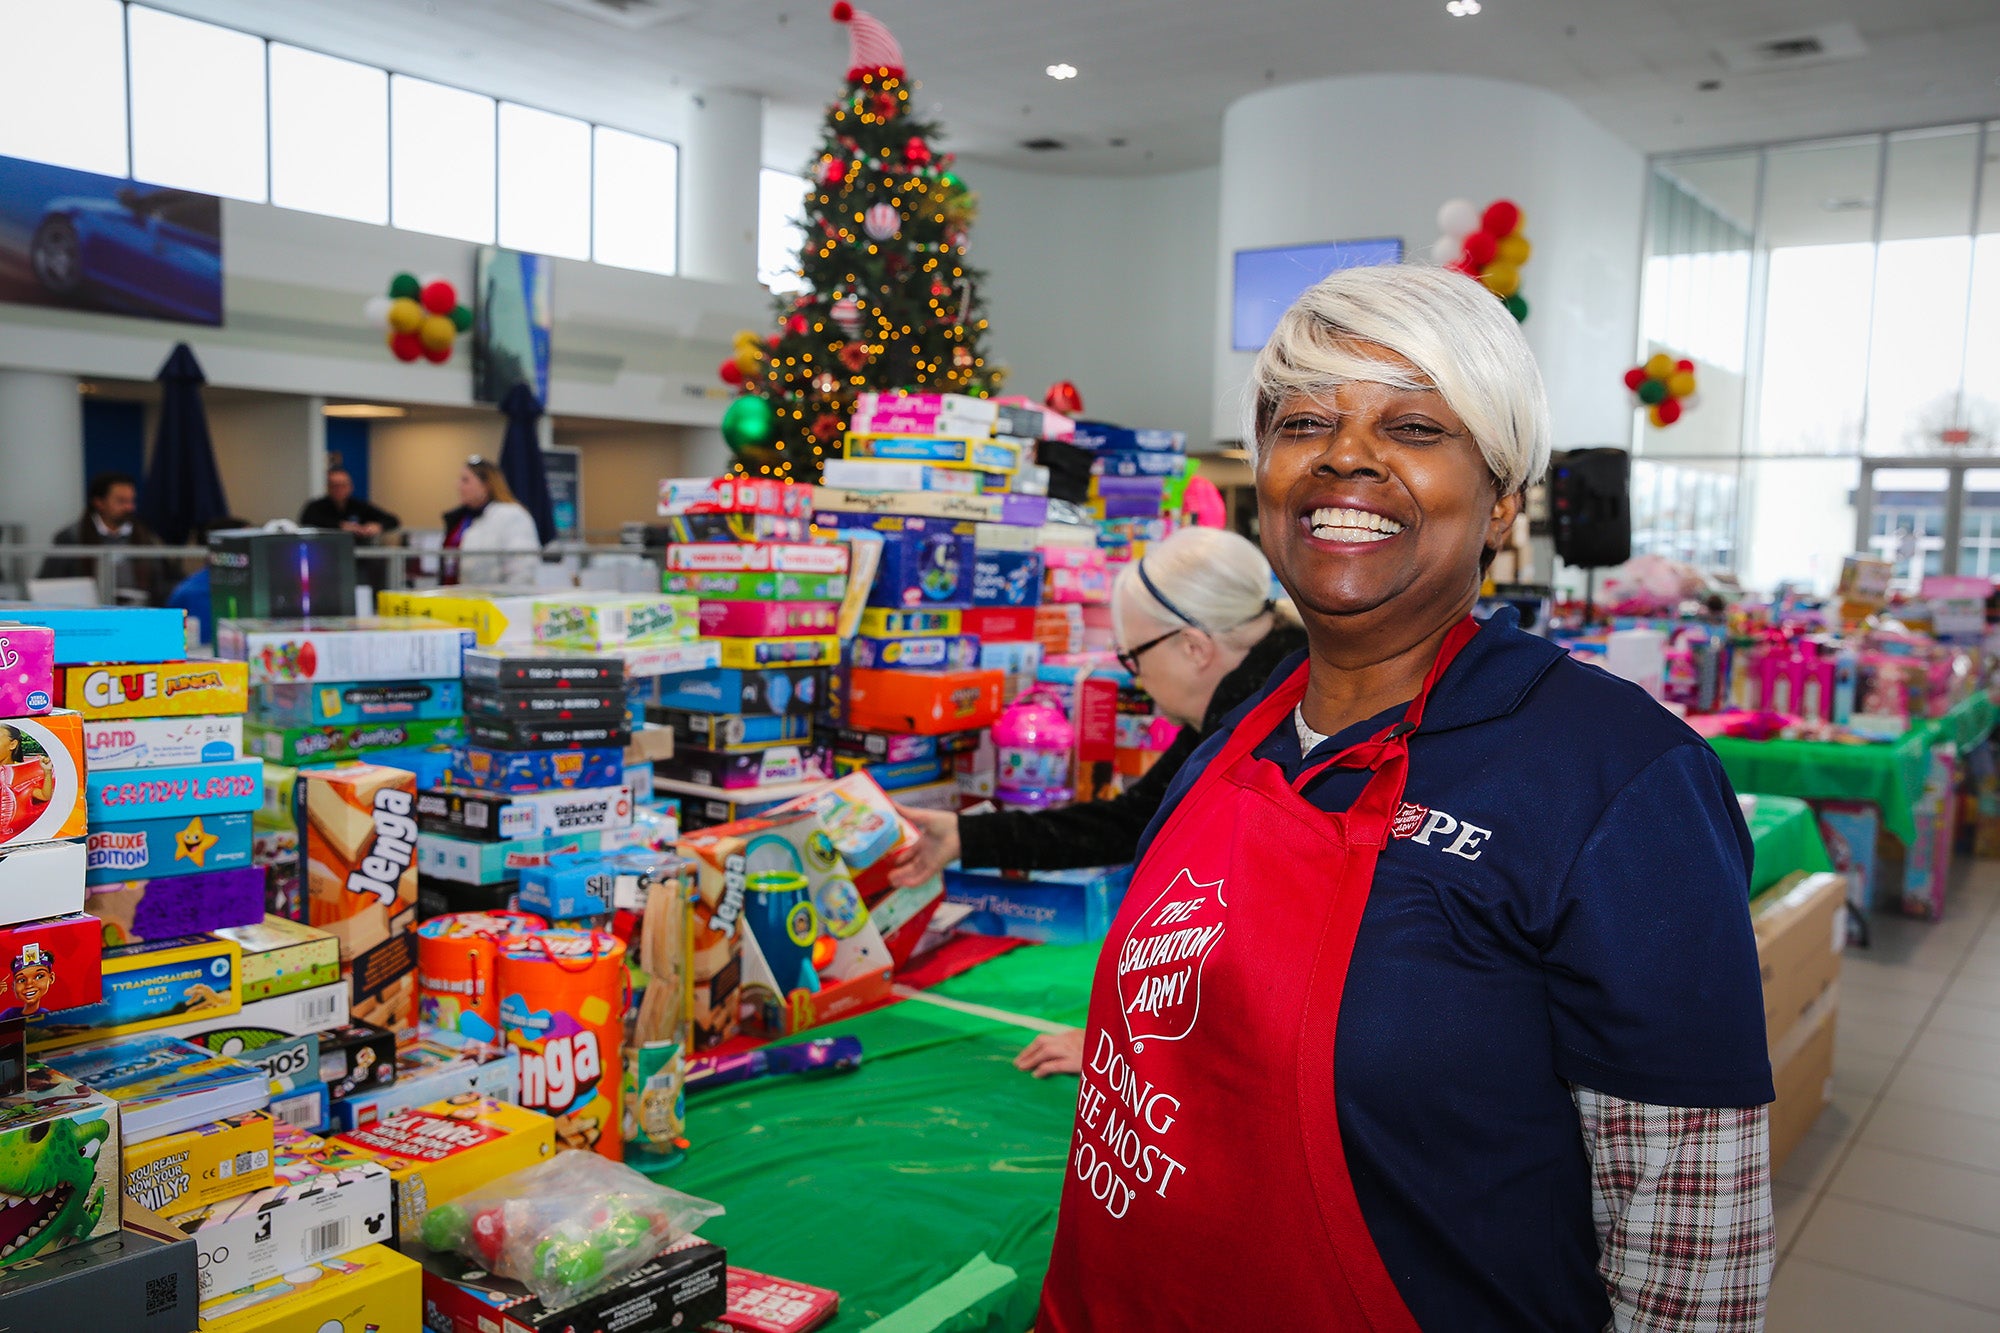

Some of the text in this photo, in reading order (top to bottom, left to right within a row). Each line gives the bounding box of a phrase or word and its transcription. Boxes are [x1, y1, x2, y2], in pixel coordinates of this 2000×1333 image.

[83, 670, 223, 708] CLUE JUNIOR
[87, 730, 136, 749] LAND
[101, 775, 255, 807] CANDY LAND
[88, 849, 146, 867] EDITION
[89, 833, 145, 851] DELUXE
[346, 787, 419, 907] Jenga
[708, 854, 745, 938] Jenga
[1151, 898, 1206, 927] THE
[1120, 922, 1223, 976] SALVATION
[112, 969, 203, 992] TYRANNOSAURUS
[147, 987, 168, 996] REX
[1126, 965, 1192, 1017] ARMY
[508, 1030, 600, 1108] nga
[1090, 1028, 1181, 1134] DOING
[1078, 1068, 1187, 1199] HE MOST
[131, 1150, 190, 1181] YOU REALLY
[155, 1165, 183, 1184] YOUR
[133, 1175, 191, 1211] MILY?
